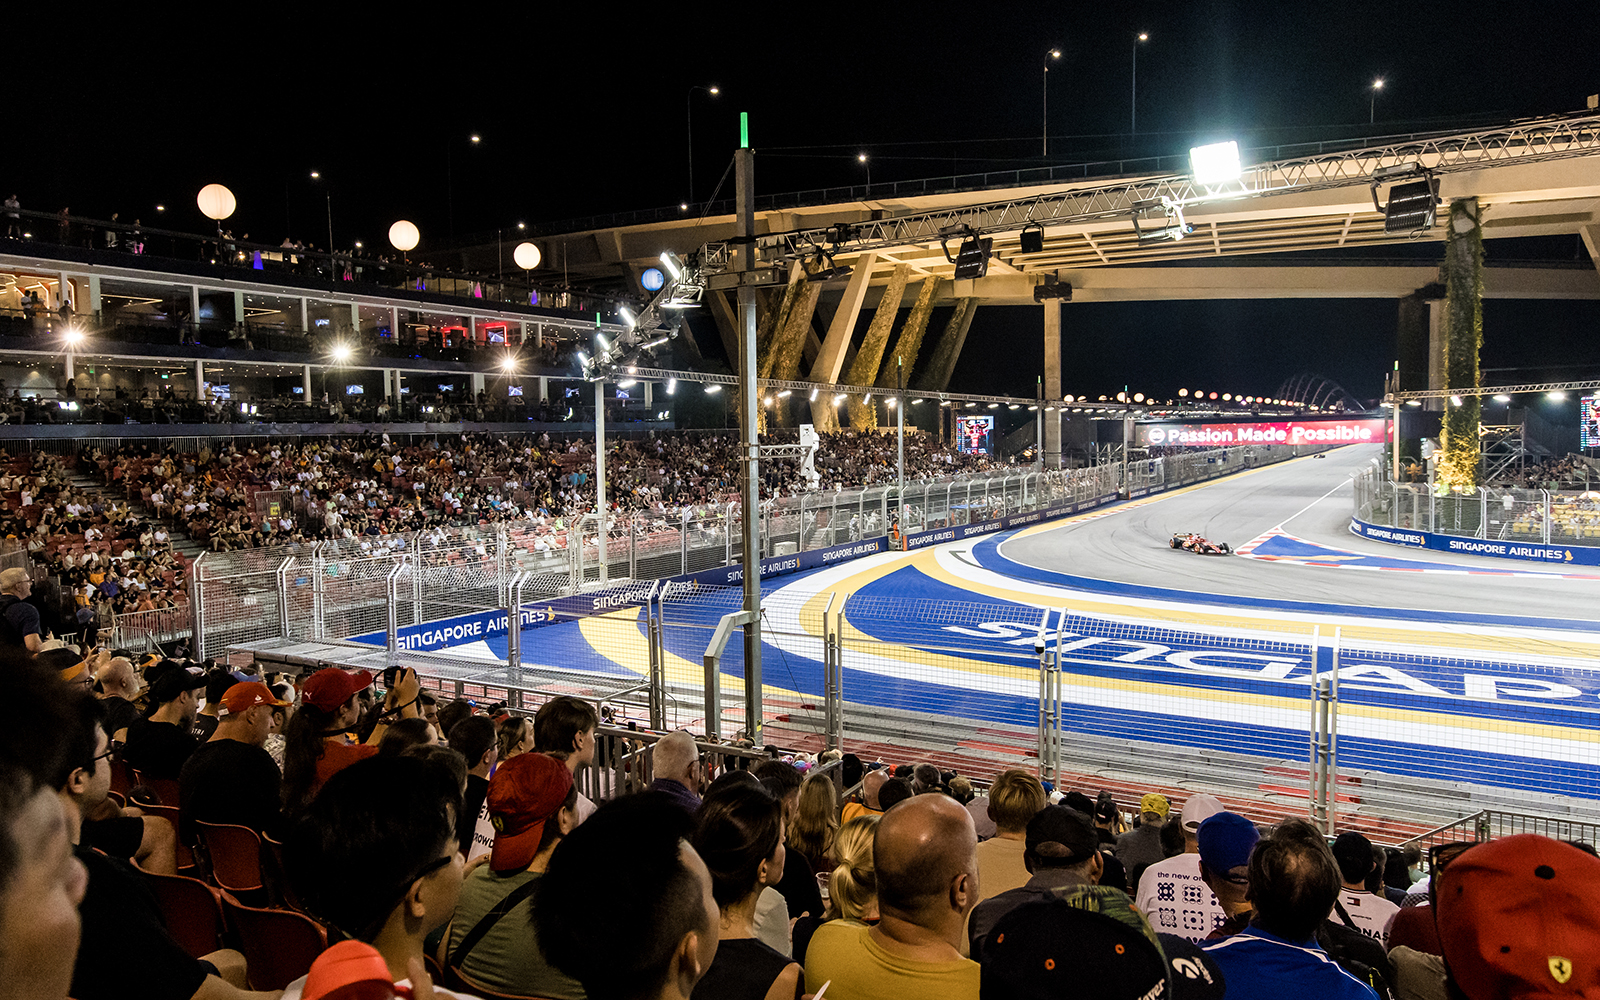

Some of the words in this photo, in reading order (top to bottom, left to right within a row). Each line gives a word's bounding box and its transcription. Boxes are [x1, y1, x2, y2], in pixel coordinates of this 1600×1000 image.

[1168, 427, 1233, 443] Passion
[1237, 427, 1287, 442] Made
[1292, 425, 1372, 442] Possible
[964, 525, 984, 536] SINGAPORE
[984, 522, 999, 531] AIRLINES
[1366, 527, 1391, 539] SINGAPORE
[1392, 533, 1420, 543] AIRLINES
[909, 534, 933, 547] SINGAPORE
[934, 531, 952, 541] AIRLINES
[823, 546, 852, 562] SINGAPORE
[853, 543, 876, 555] AIRLINES
[1449, 540, 1506, 555] SINGAPORE
[1509, 546, 1563, 559] AIRLINES
[727, 565, 766, 582] SINGRE
[768, 559, 796, 573] AIRLINES
[593, 587, 652, 610] SINGAPOR
[396, 621, 482, 650] SINGAPORE
[486, 610, 545, 633] AIRNES
[941, 621, 1600, 700] SINGAP
